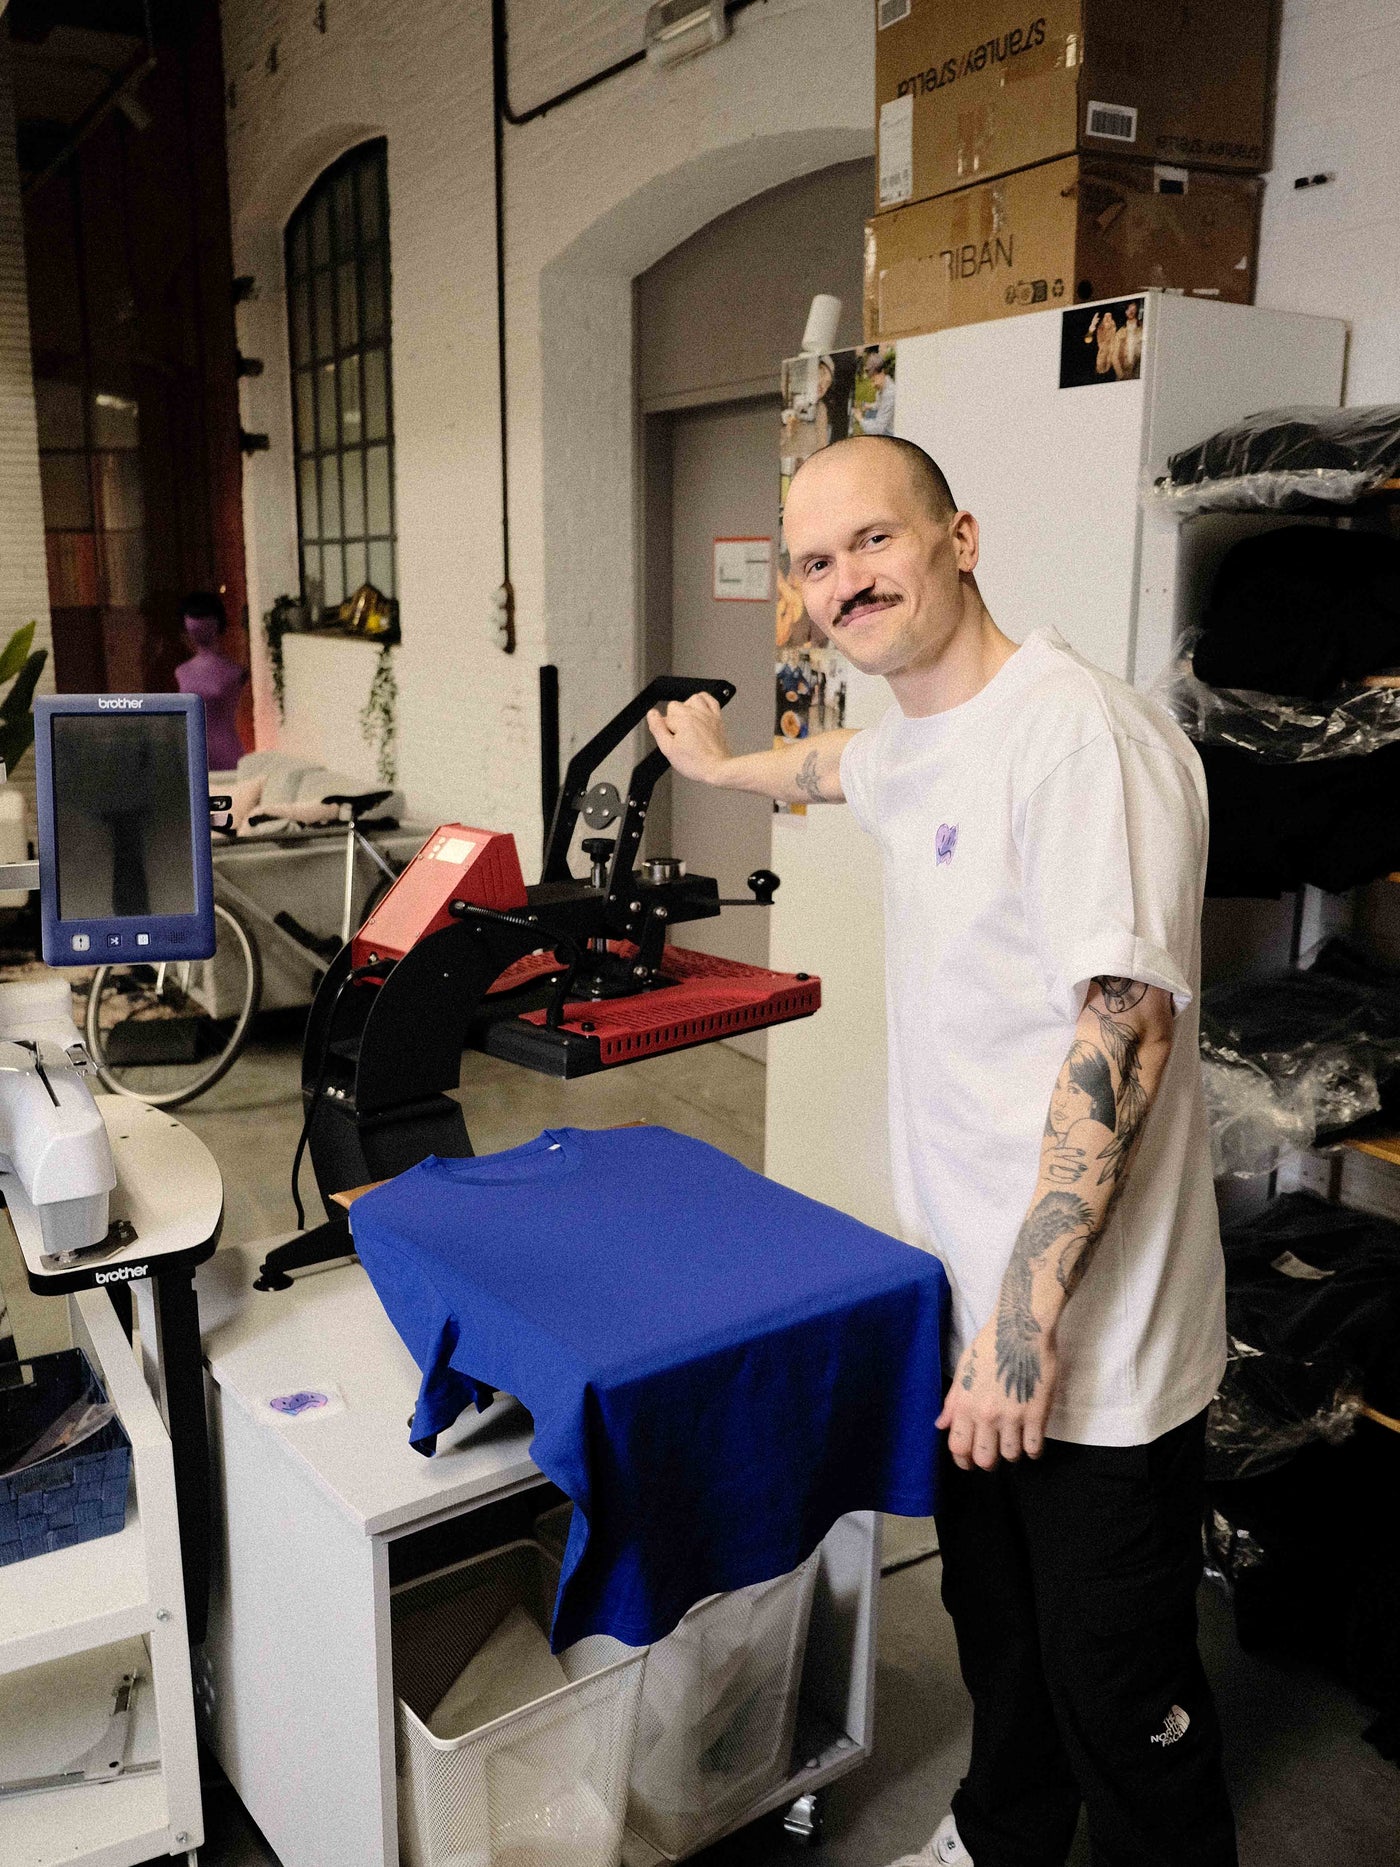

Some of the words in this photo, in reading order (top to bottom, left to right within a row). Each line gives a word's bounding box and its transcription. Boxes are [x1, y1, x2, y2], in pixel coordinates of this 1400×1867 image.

[918, 234, 1013, 280] RIBAN
[98, 697, 143, 709] brother
[95, 1264, 149, 1285] brother
